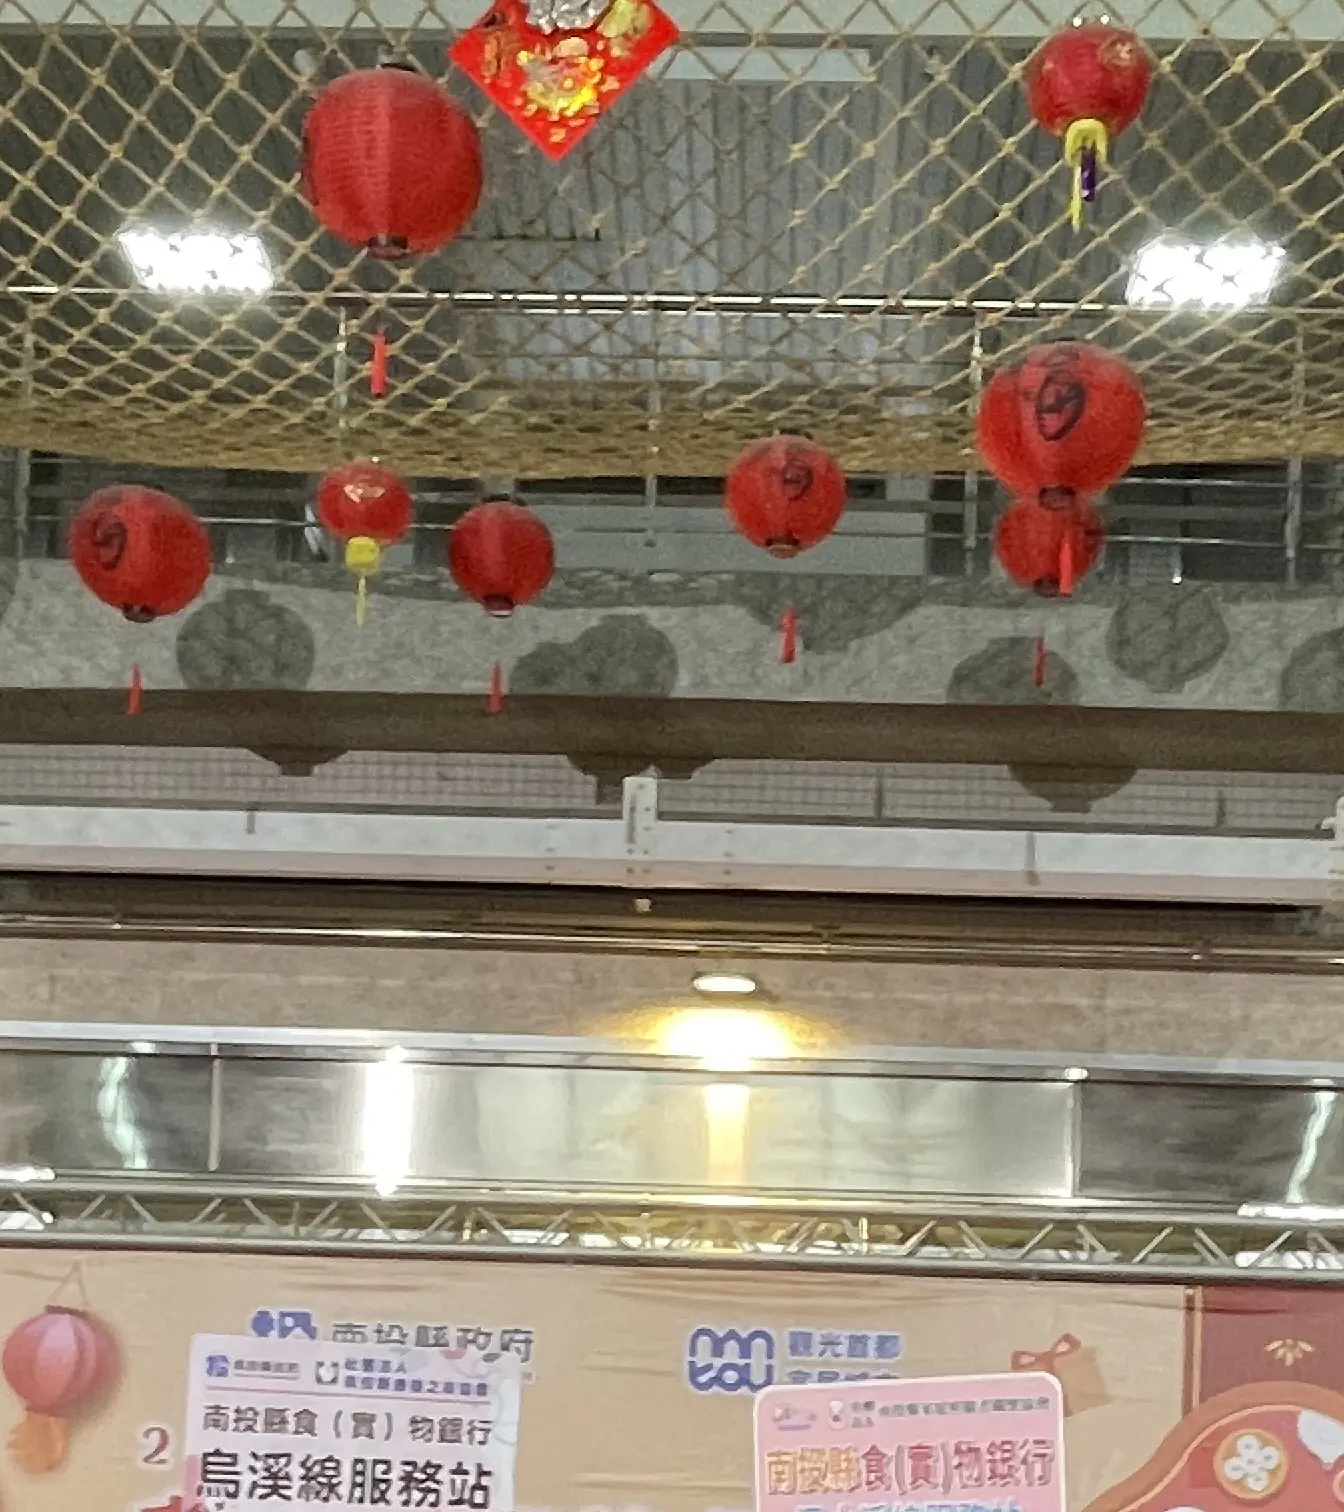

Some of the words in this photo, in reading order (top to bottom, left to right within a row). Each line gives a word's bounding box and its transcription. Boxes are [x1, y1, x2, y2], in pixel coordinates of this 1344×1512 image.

[201, 1449, 493, 1510] 烏溪線服務站
